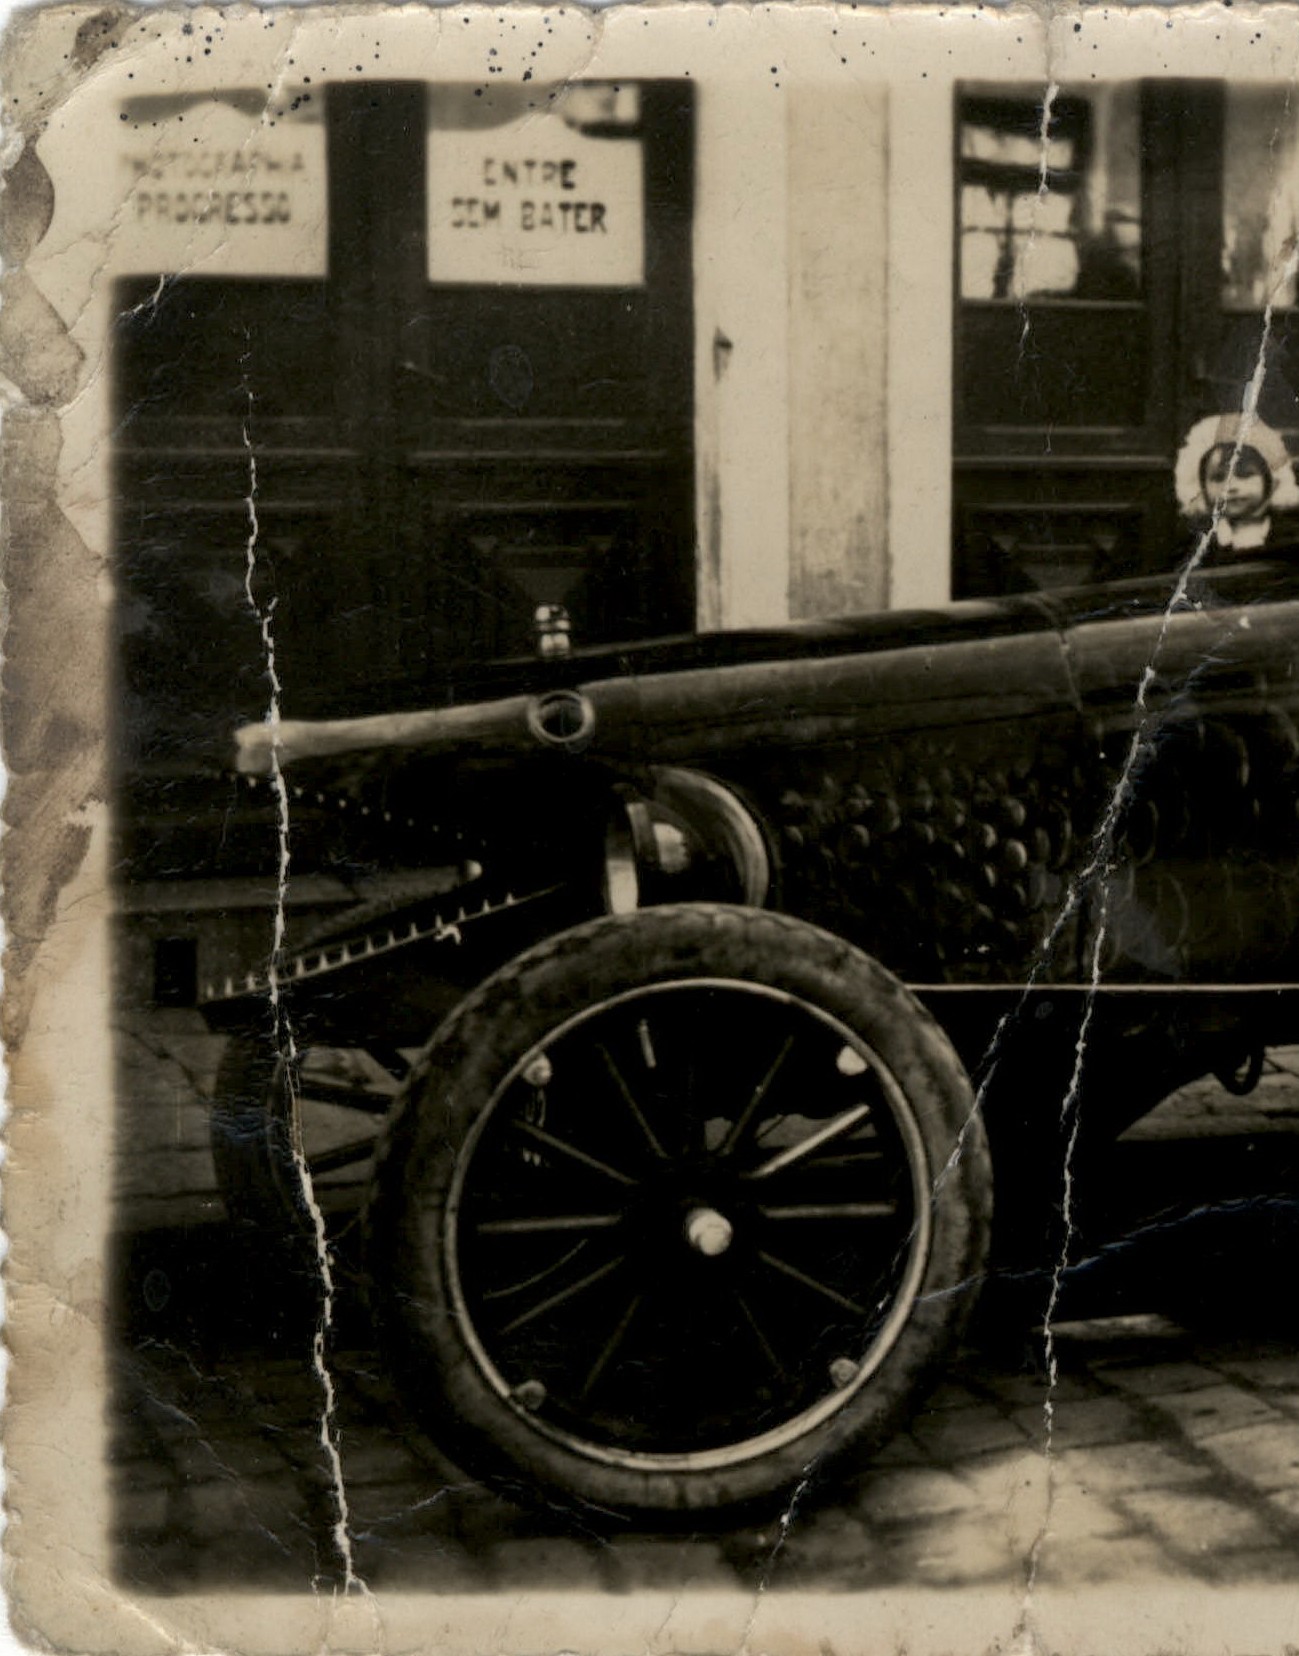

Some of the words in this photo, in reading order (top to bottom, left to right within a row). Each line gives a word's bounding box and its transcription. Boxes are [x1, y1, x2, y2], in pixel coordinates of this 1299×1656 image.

[484, 157, 577, 190] ENTRE
[137, 190, 291, 226] PROGRESSO
[451, 197, 501, 229] SEM
[521, 200, 608, 235] BATER
